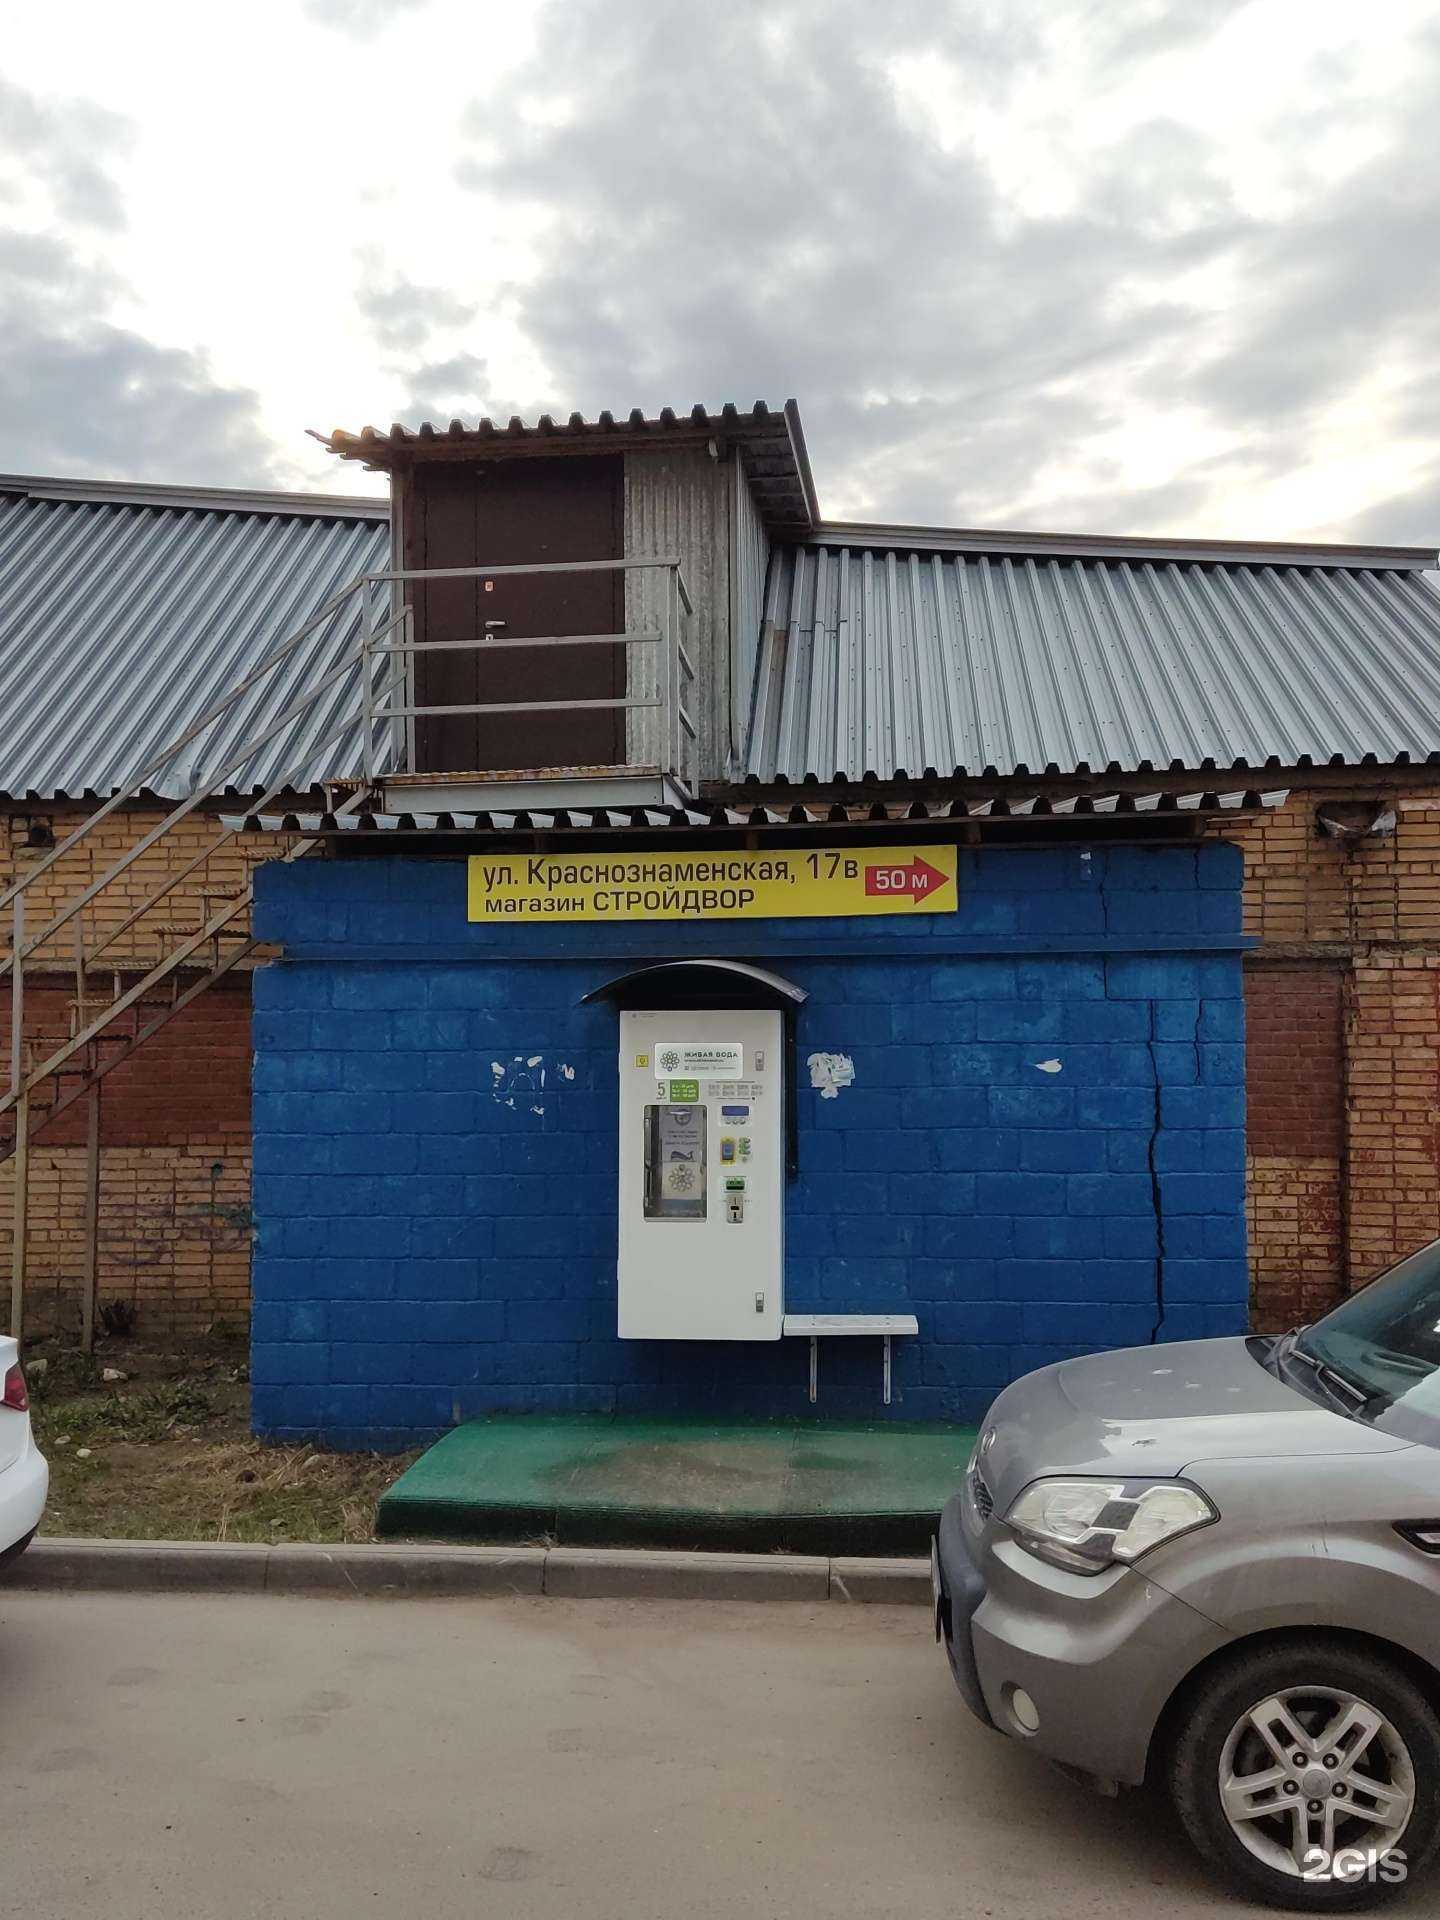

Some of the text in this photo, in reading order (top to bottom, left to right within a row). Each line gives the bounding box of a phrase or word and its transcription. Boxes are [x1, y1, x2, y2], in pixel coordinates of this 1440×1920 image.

[483, 853, 858, 892] ул. Краснознаменская, 17в
[876, 870, 928, 889] 50 м
[485, 886, 755, 914] магазин СТРОЙДВОР
